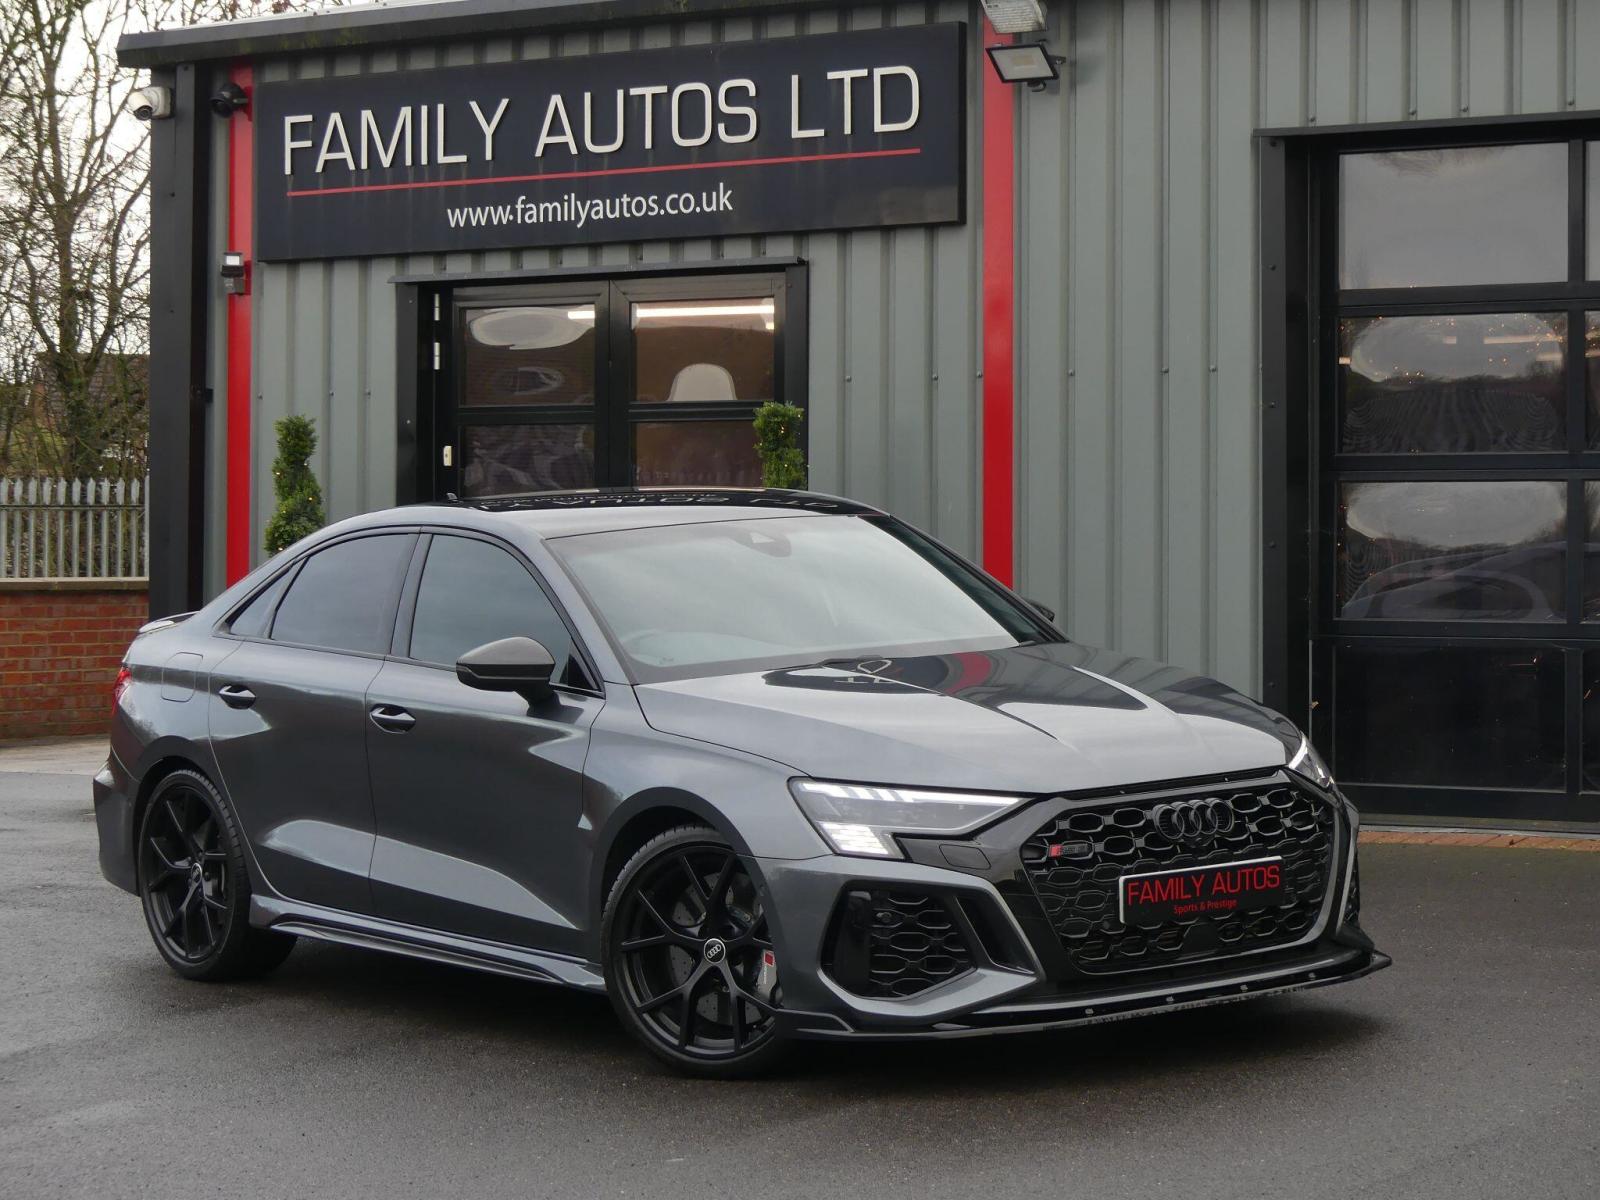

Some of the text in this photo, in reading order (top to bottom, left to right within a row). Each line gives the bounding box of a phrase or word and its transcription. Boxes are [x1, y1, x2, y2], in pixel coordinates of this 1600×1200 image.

[284, 65, 920, 175] FAMILY AUTOS LTD
[447, 182, 734, 229] www.familyautos.co.uk
[1127, 864, 1281, 906] FAMILY AUTOS
[1173, 903, 1198, 916] Sports
[1207, 899, 1237, 909] Prestige
